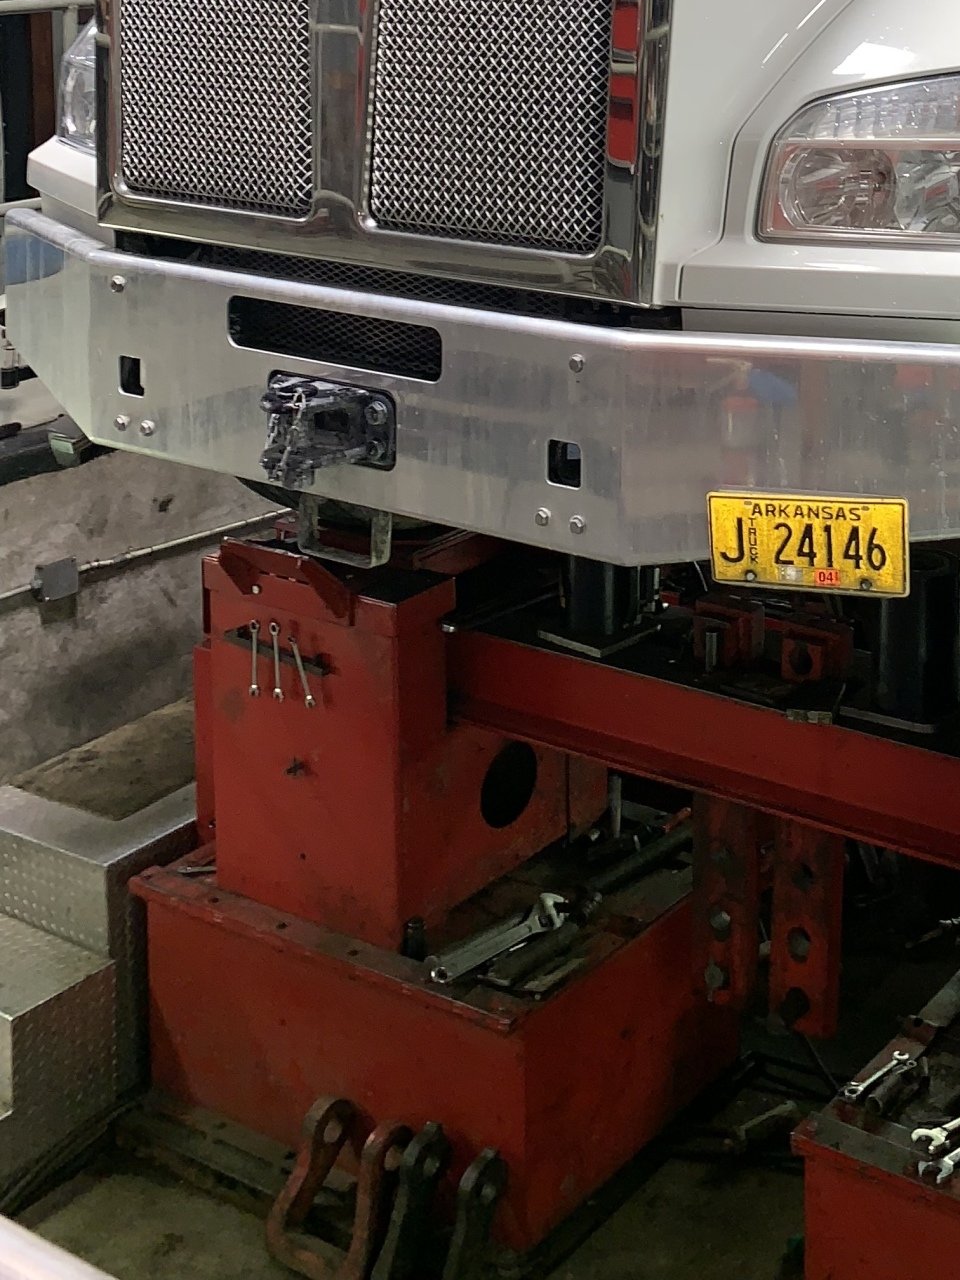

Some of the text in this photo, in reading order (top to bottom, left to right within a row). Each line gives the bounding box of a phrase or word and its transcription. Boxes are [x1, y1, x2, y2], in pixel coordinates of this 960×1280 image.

[751, 503, 861, 521] ARKANSAS
[720, 517, 886, 571] J 24146
[748, 517, 759, 564] TRUCK
